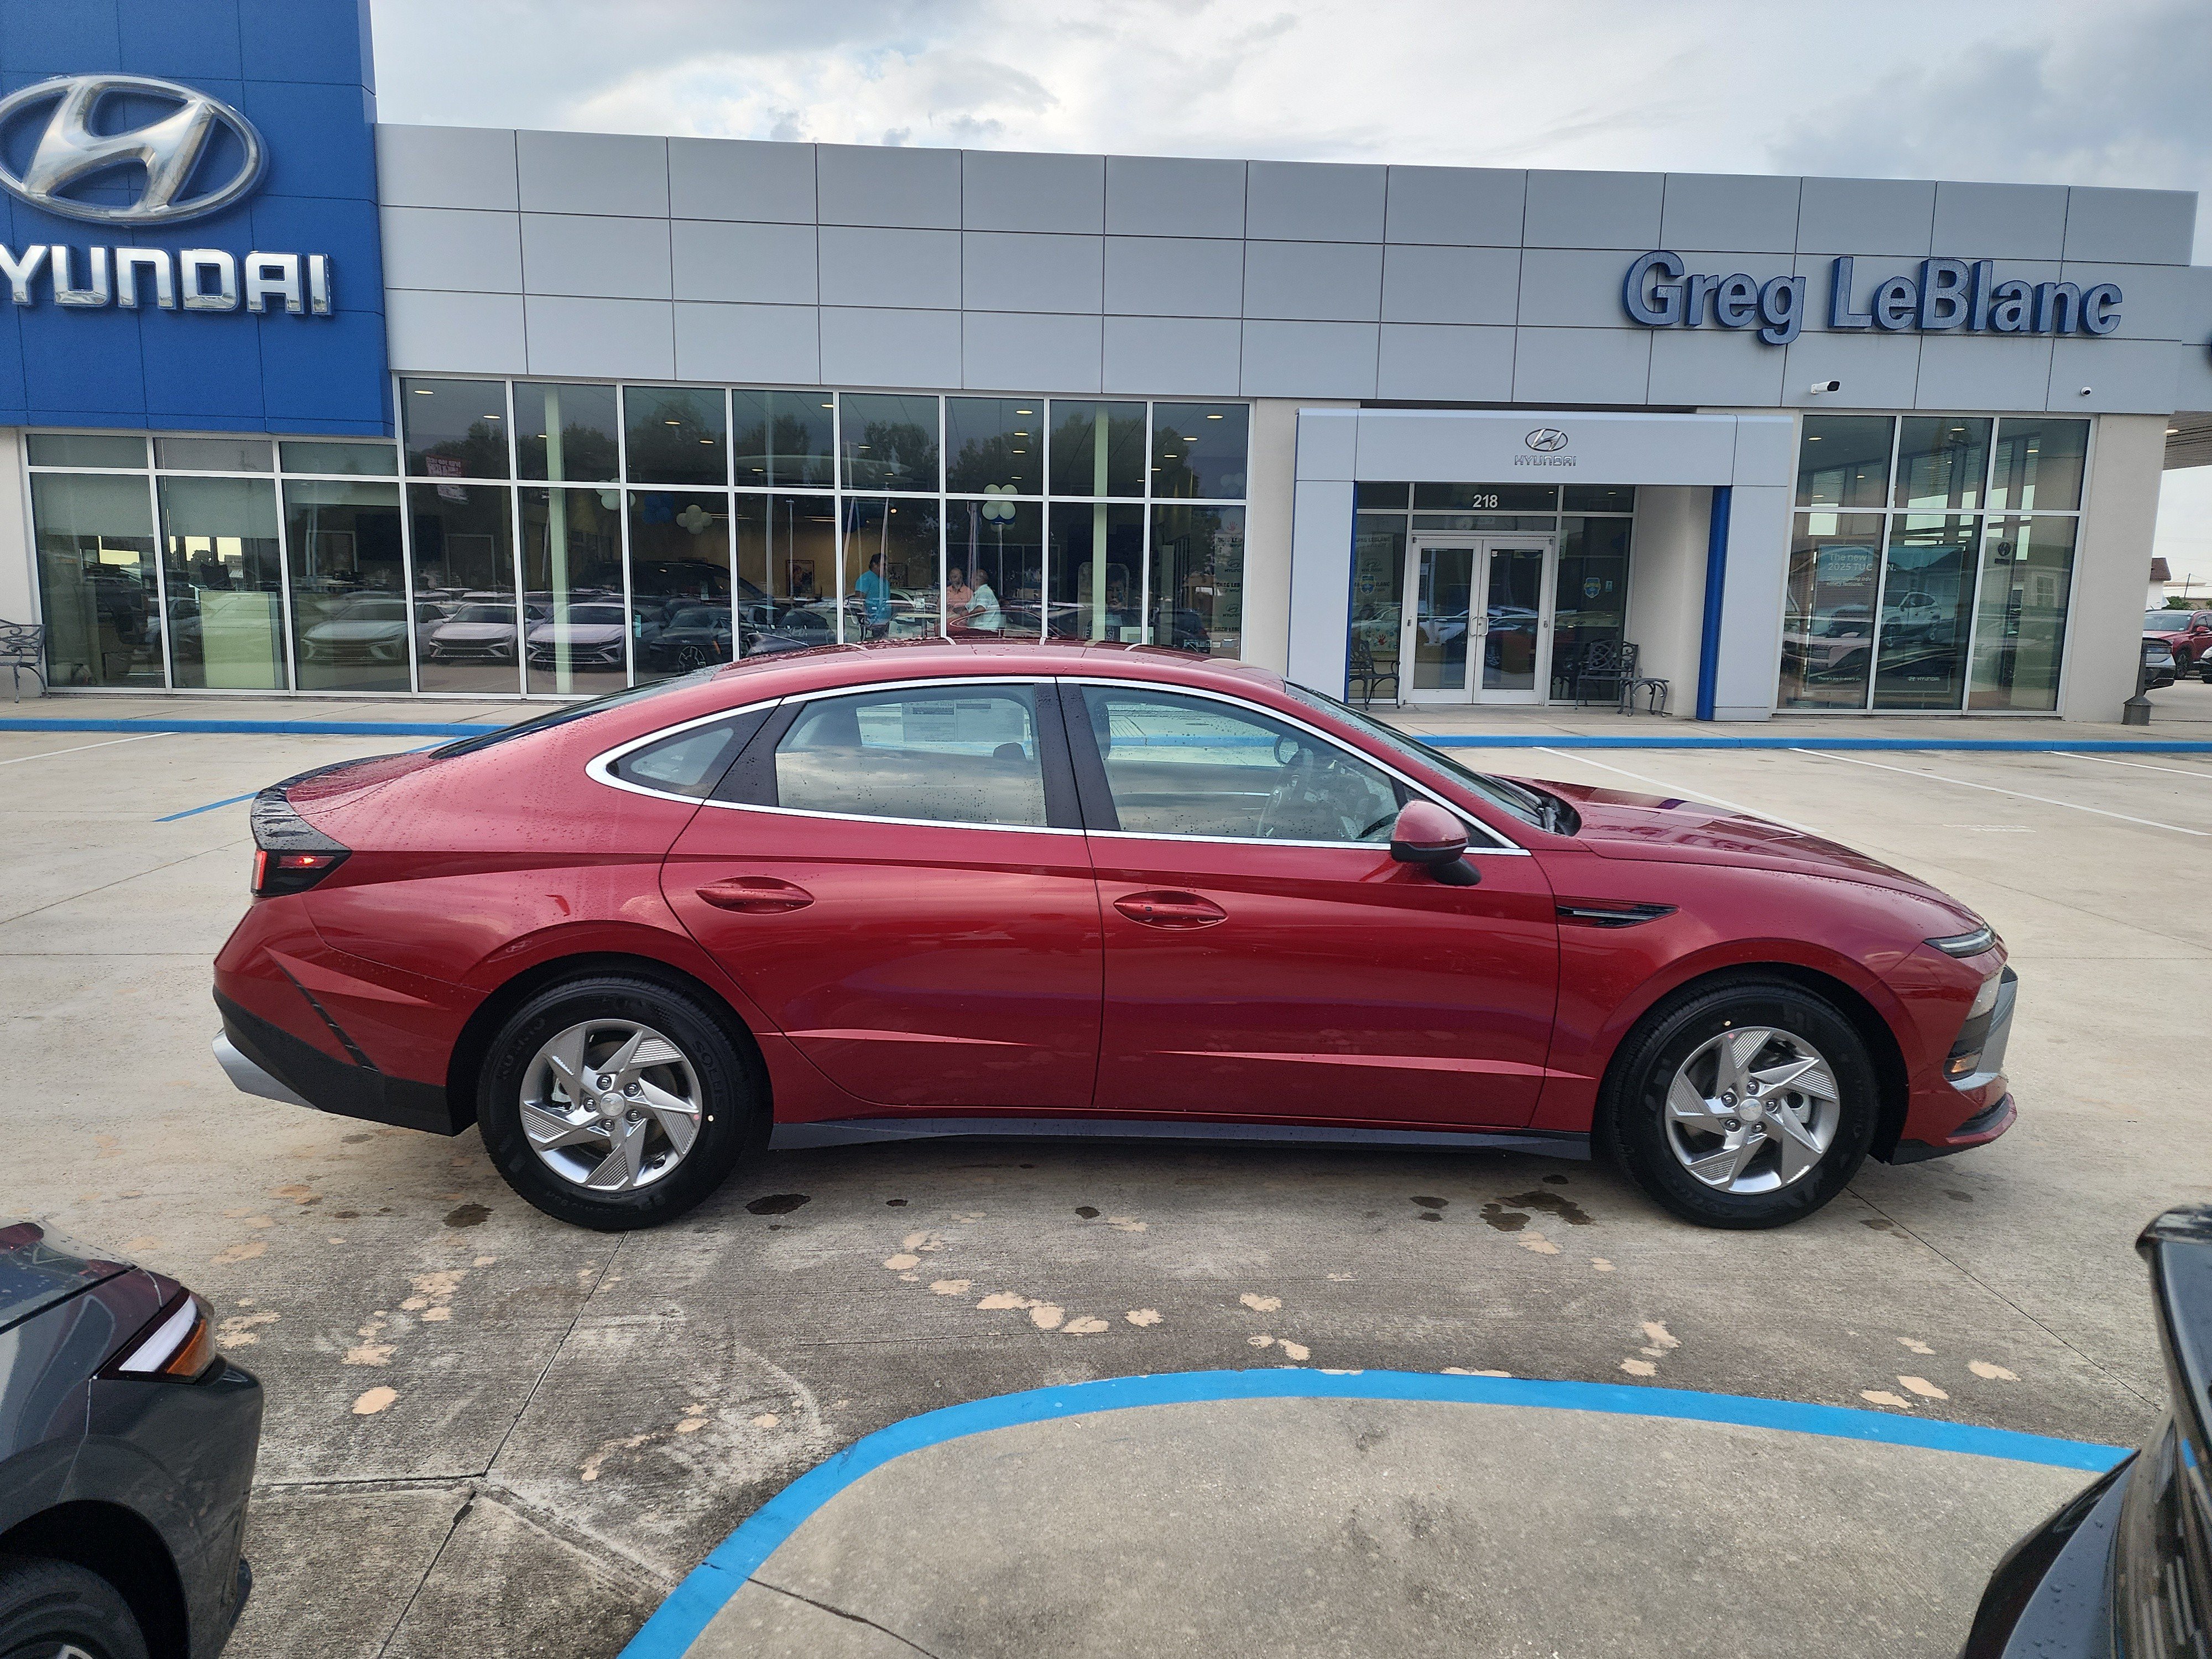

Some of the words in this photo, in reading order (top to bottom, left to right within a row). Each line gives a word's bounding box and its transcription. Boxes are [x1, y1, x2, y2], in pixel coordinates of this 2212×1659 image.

[0, 243, 333, 316] YUNDAI
[1623, 250, 1806, 346] Greg
[1827, 256, 2122, 335] LeBlanc
[1514, 455, 1577, 467] HYUNDAI
[1473, 494, 1498, 508] 218
[1827, 563, 1851, 571] 2025
[1853, 563, 1896, 572] TUCN.
